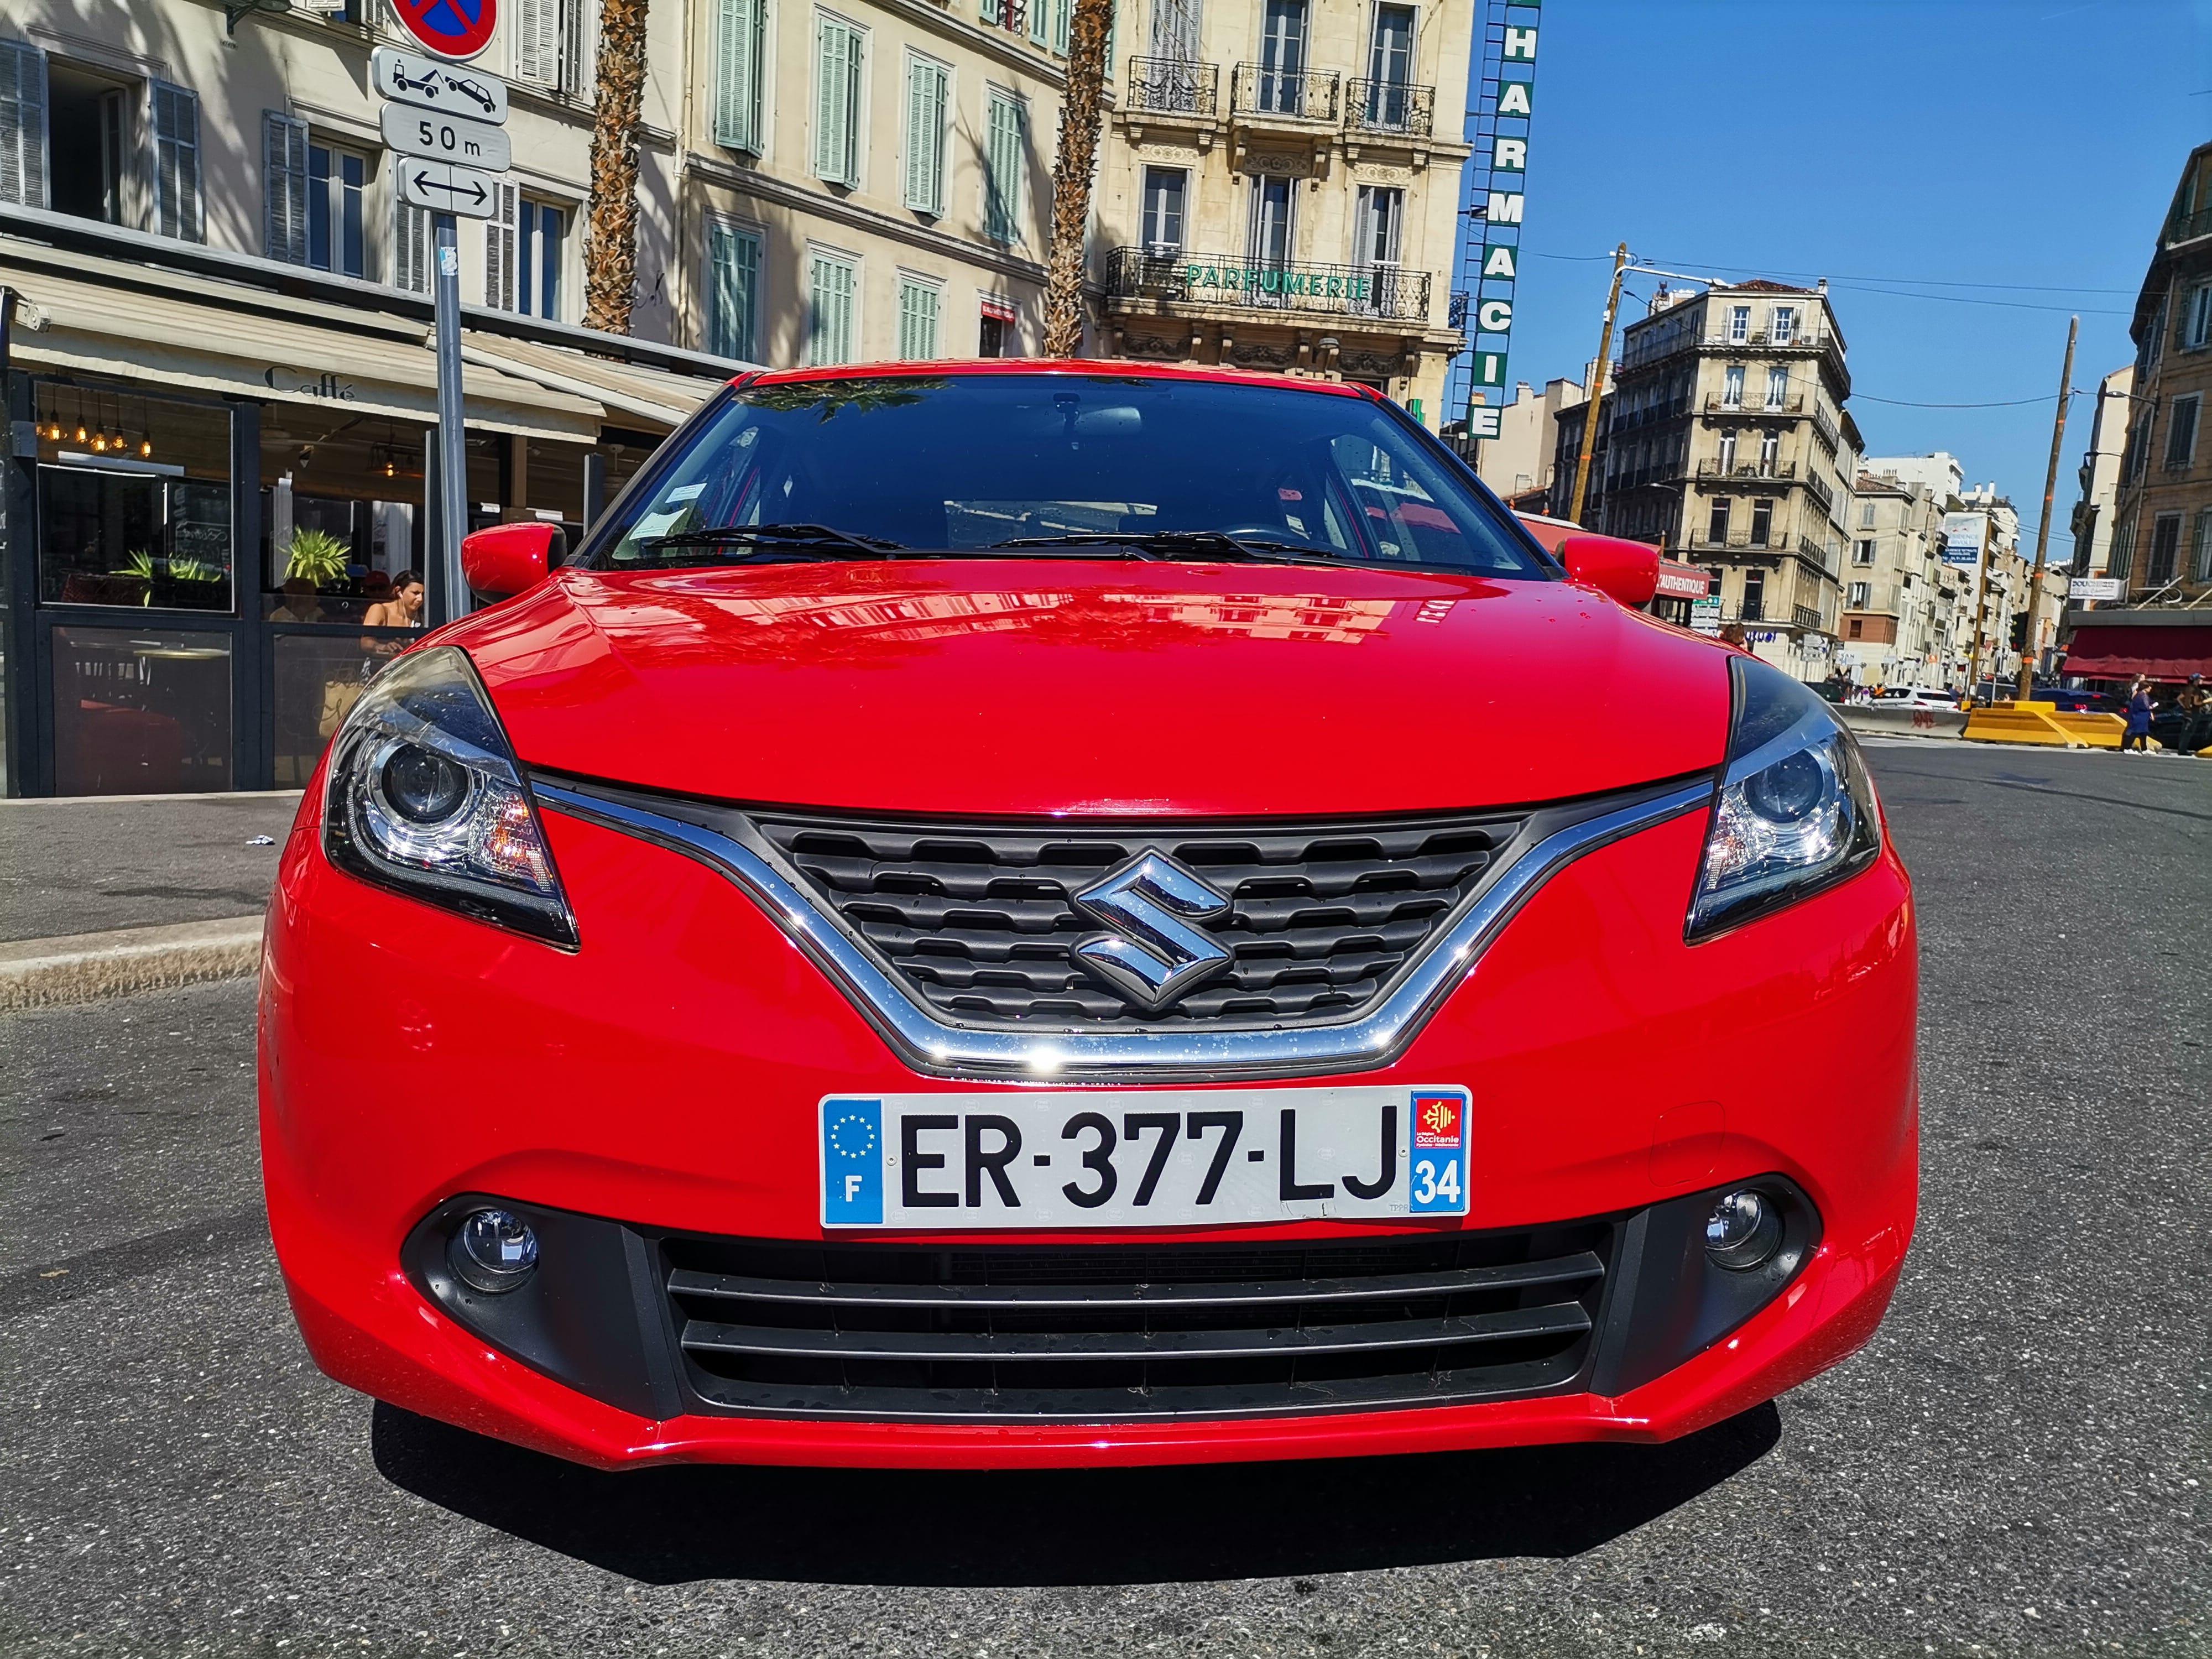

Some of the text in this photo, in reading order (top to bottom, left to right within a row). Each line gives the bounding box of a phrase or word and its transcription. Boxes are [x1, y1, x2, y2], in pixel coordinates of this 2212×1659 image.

[419, 121, 481, 156] 50 m
[1472, 0, 1537, 435] HARMACIE
[1187, 265, 1371, 299] PARFUMERIE
[265, 366, 355, 401] Caffé
[1656, 573, 1705, 595] 'AUTHENTIQUE
[901, 1105, 1397, 1208] ER-377-LJ
[1416, 1135, 1459, 1143] Occitanie
[845, 1175, 863, 1202] F
[1414, 1160, 1460, 1204] 34
